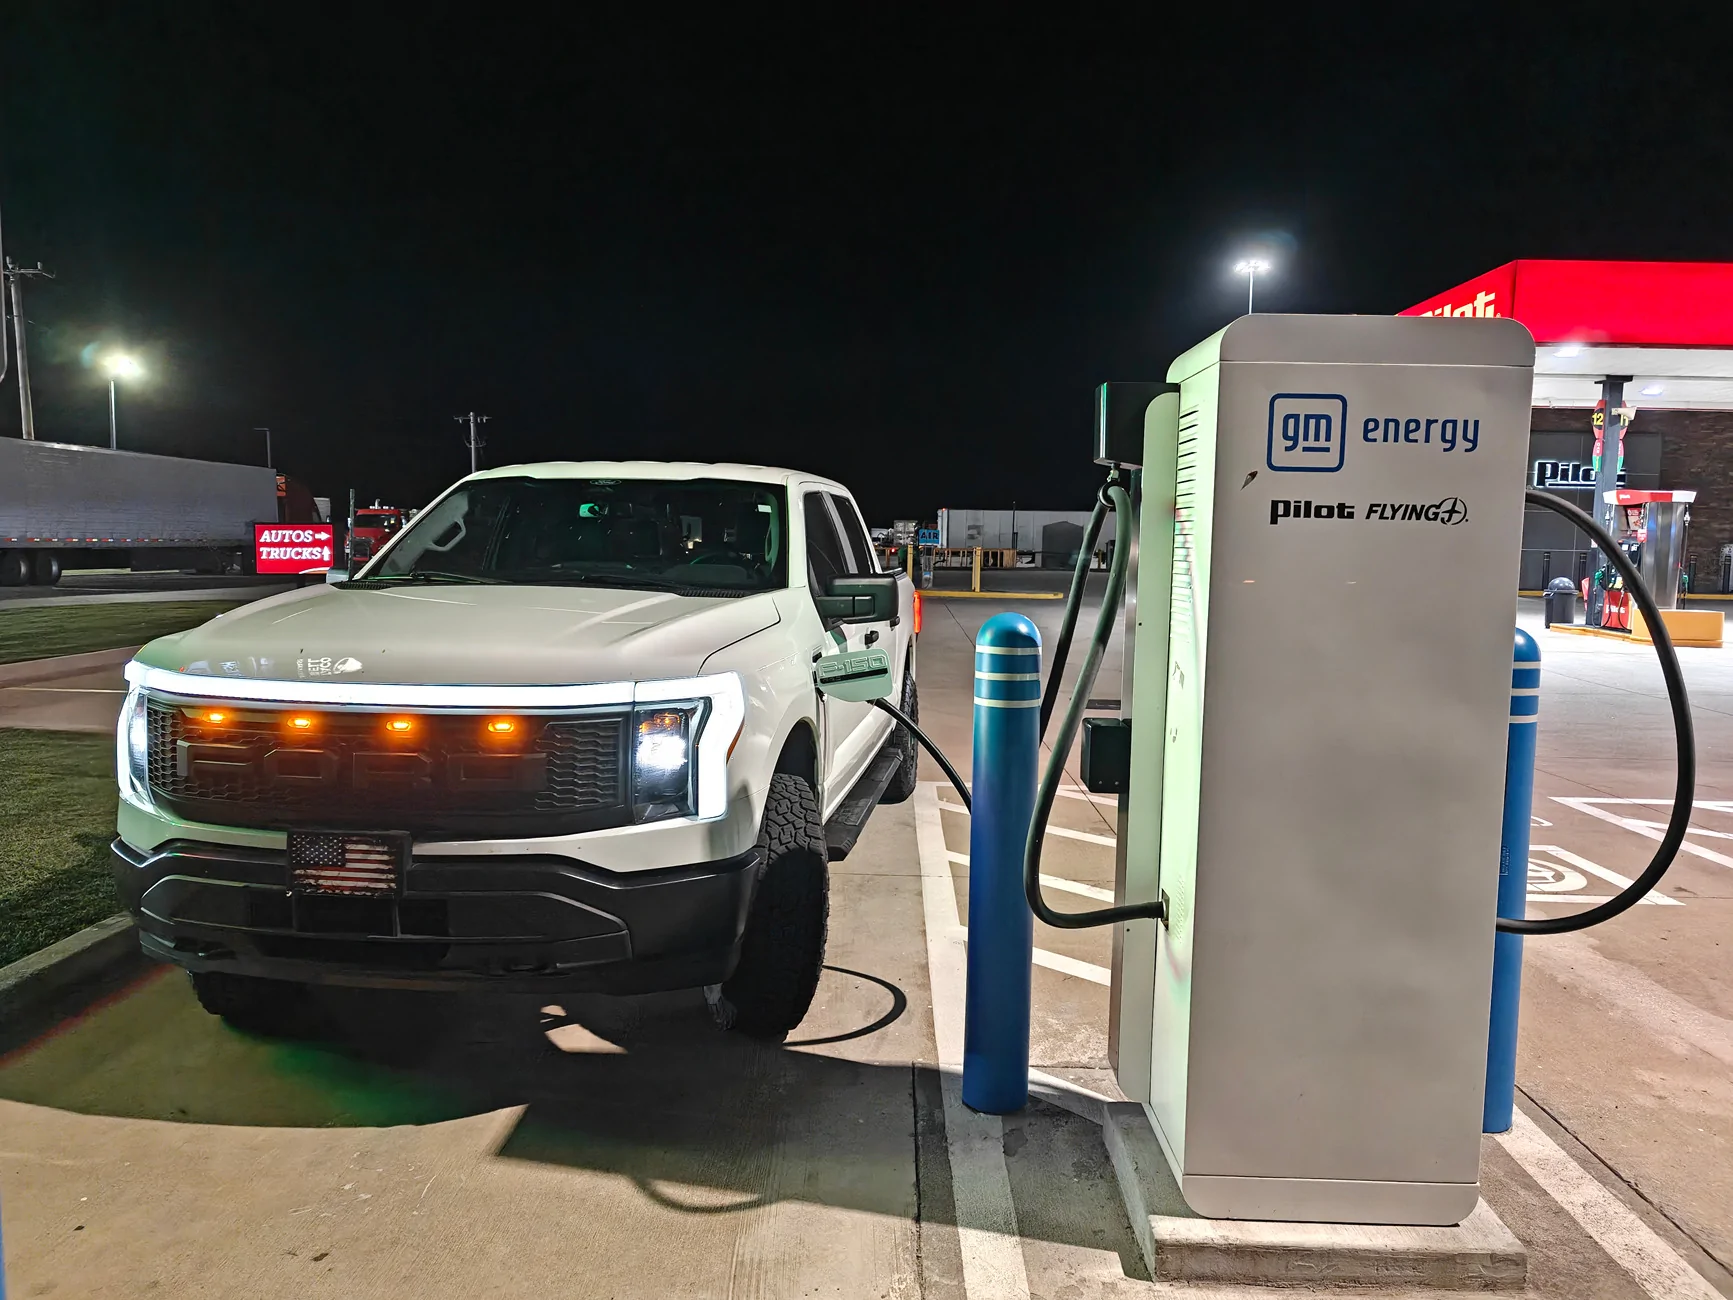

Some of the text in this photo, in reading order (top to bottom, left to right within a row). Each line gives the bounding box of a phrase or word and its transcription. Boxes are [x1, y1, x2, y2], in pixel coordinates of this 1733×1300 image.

[1592, 412, 1604, 426] 12
[1282, 413, 1480, 453] gm energy
[1269, 499, 1355, 525] Pilot
[259, 529, 313, 543] AUTOS
[920, 531, 939, 540] AIR
[259, 546, 322, 560] TRUCKS
[819, 654, 888, 678] F-150
